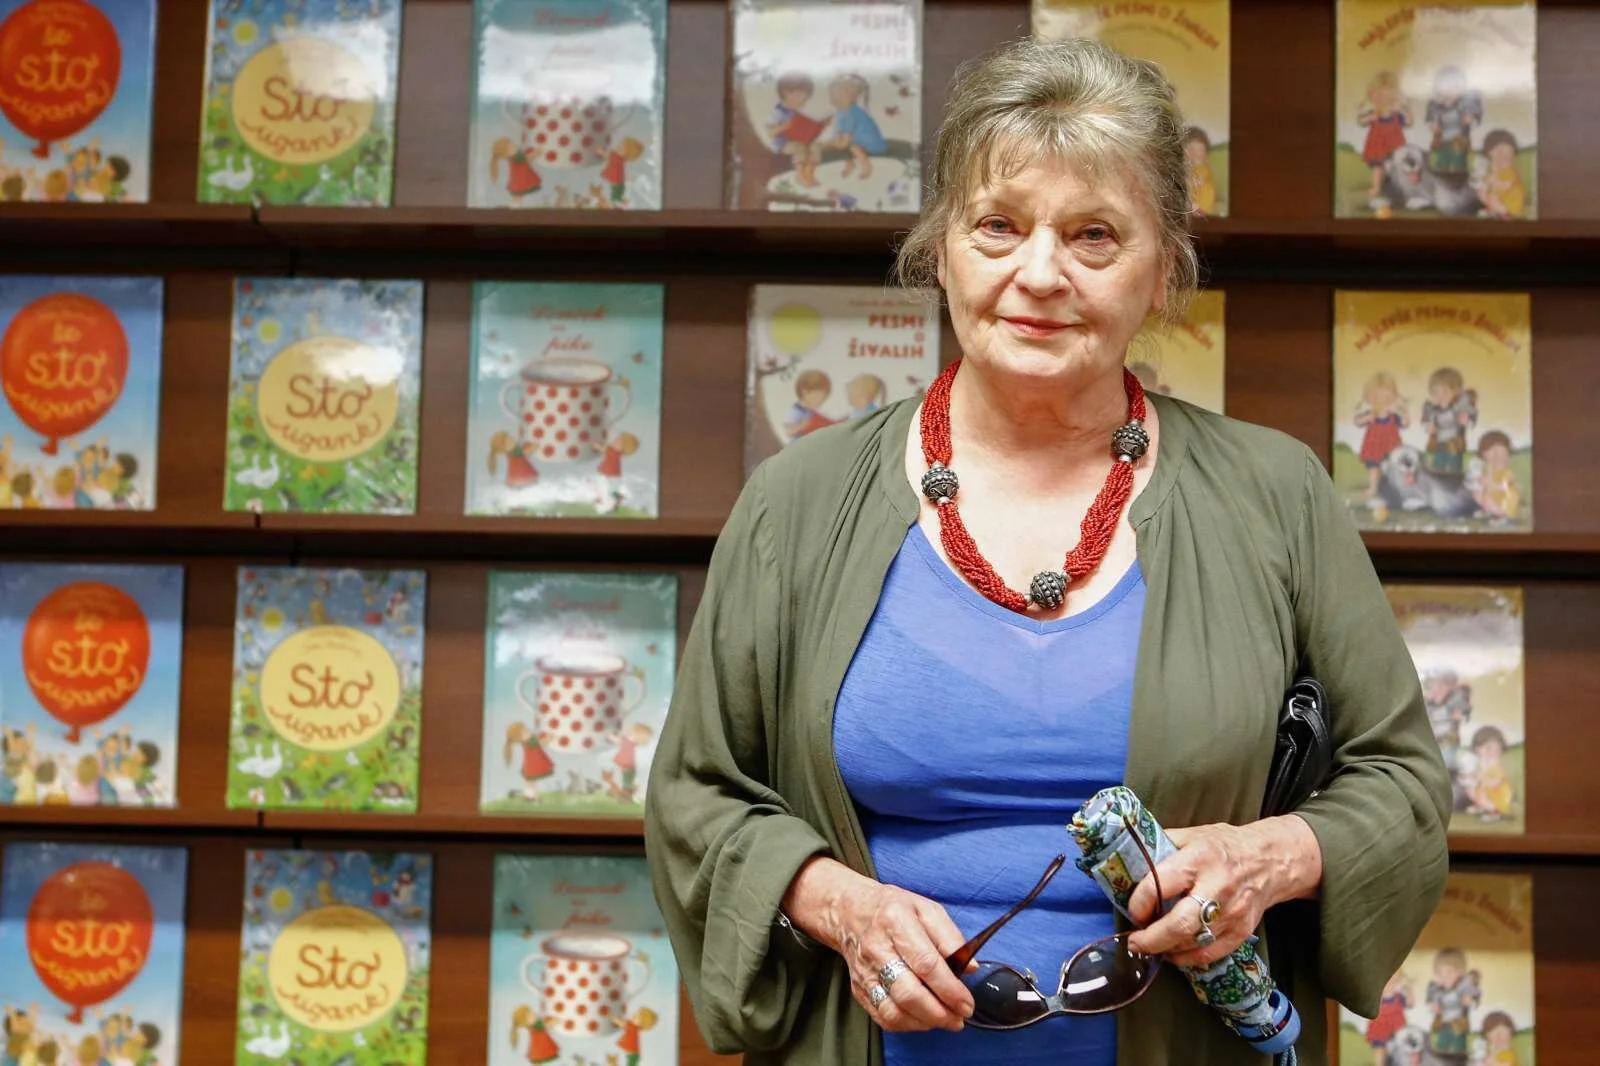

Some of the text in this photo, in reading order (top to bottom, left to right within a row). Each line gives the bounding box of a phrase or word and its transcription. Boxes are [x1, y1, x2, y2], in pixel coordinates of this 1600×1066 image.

[867, 313, 925, 329] PESMI
[25, 345, 107, 390] sto
[848, 336, 925, 358] ŽIVALIH
[286, 374, 372, 420] Sto
[46, 633, 129, 678] sto
[288, 663, 374, 710] Sto
[51, 916, 134, 958] sto
[295, 944, 381, 990] Sto
